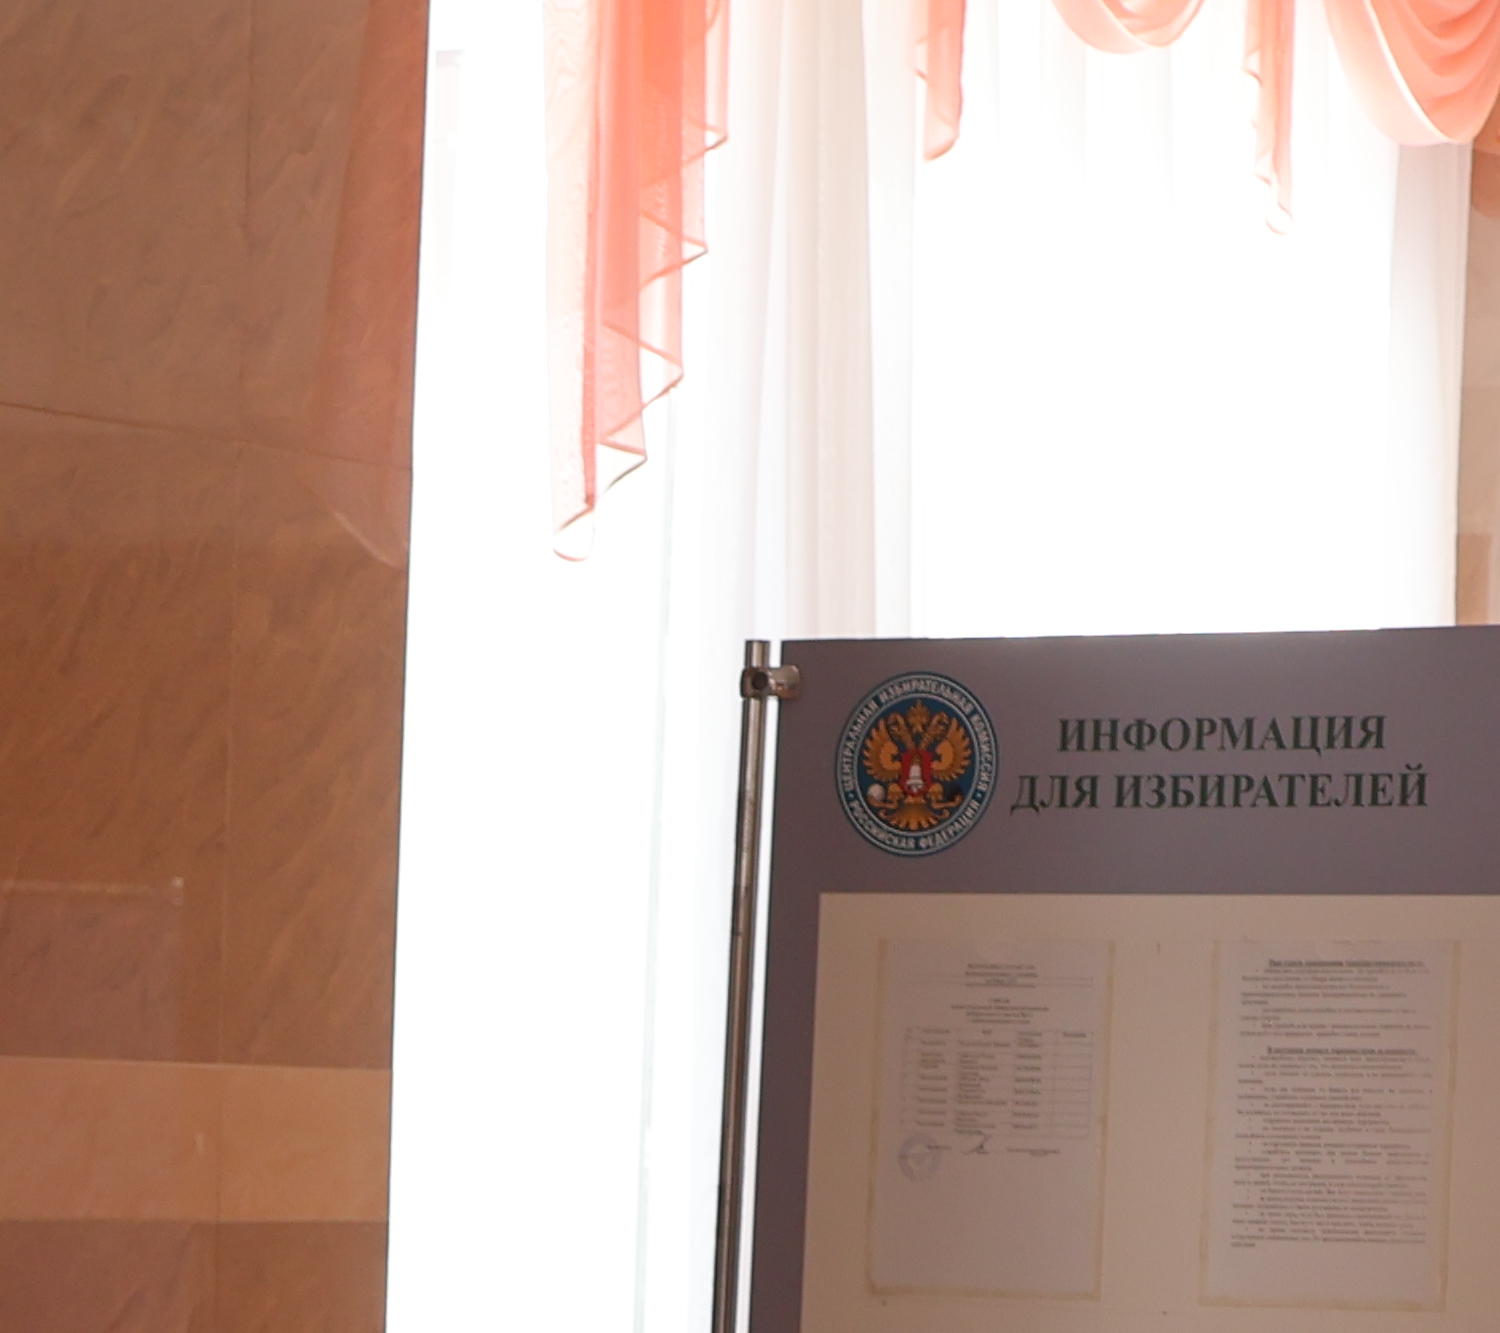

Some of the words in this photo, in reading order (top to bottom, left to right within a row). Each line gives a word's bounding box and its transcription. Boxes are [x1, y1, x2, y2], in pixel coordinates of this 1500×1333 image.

[1058, 714, 1386, 757] ИНФОРМАЦИЯ
[1009, 774, 1101, 816] ДЛЯ
[1113, 762, 1430, 810] ИЗБИРАТЕЛЕЙ
